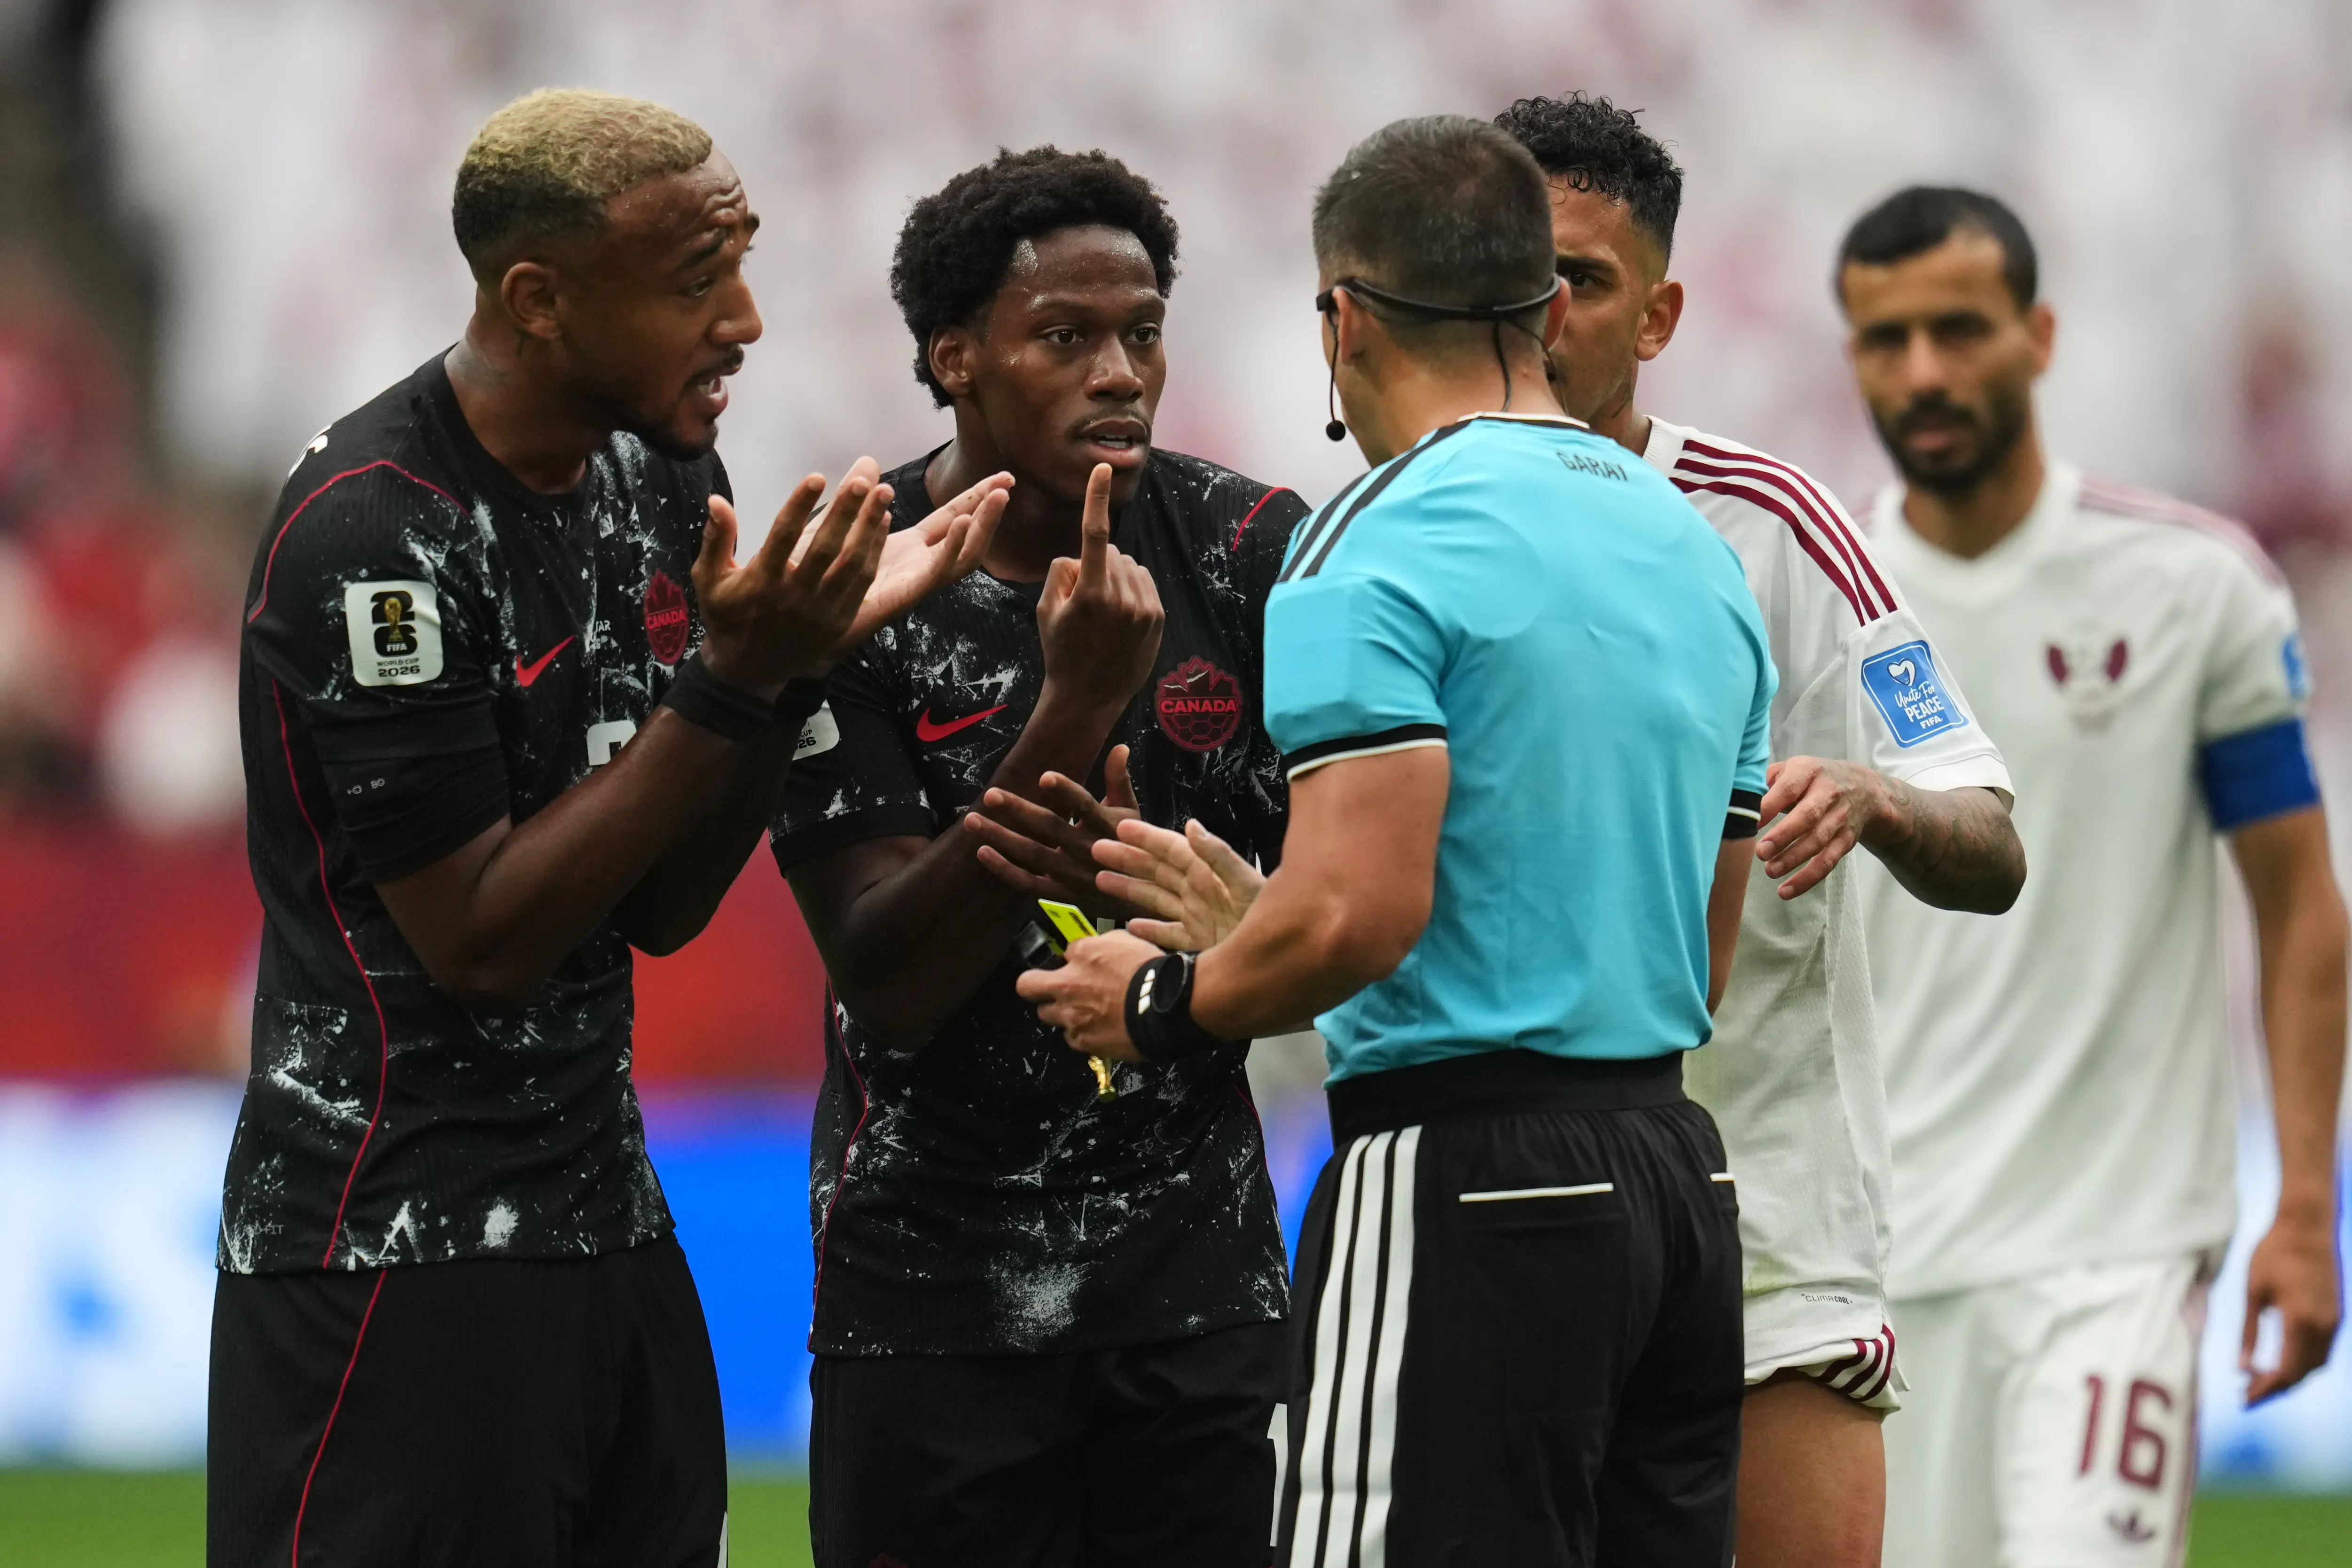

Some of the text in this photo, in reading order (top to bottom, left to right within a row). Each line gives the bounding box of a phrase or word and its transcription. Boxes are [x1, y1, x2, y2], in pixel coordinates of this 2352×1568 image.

[647, 609, 687, 630] CANADA
[386, 643, 408, 653] FIFA
[378, 665, 420, 677] 2026
[1895, 681, 1935, 708] Unite For
[1161, 700, 1237, 713] CANADA
[1904, 696, 1945, 723] PEACE
[1920, 715, 1943, 729] FIFA
[798, 736, 817, 749] 26
[2079, 1375, 2173, 1491] 16
